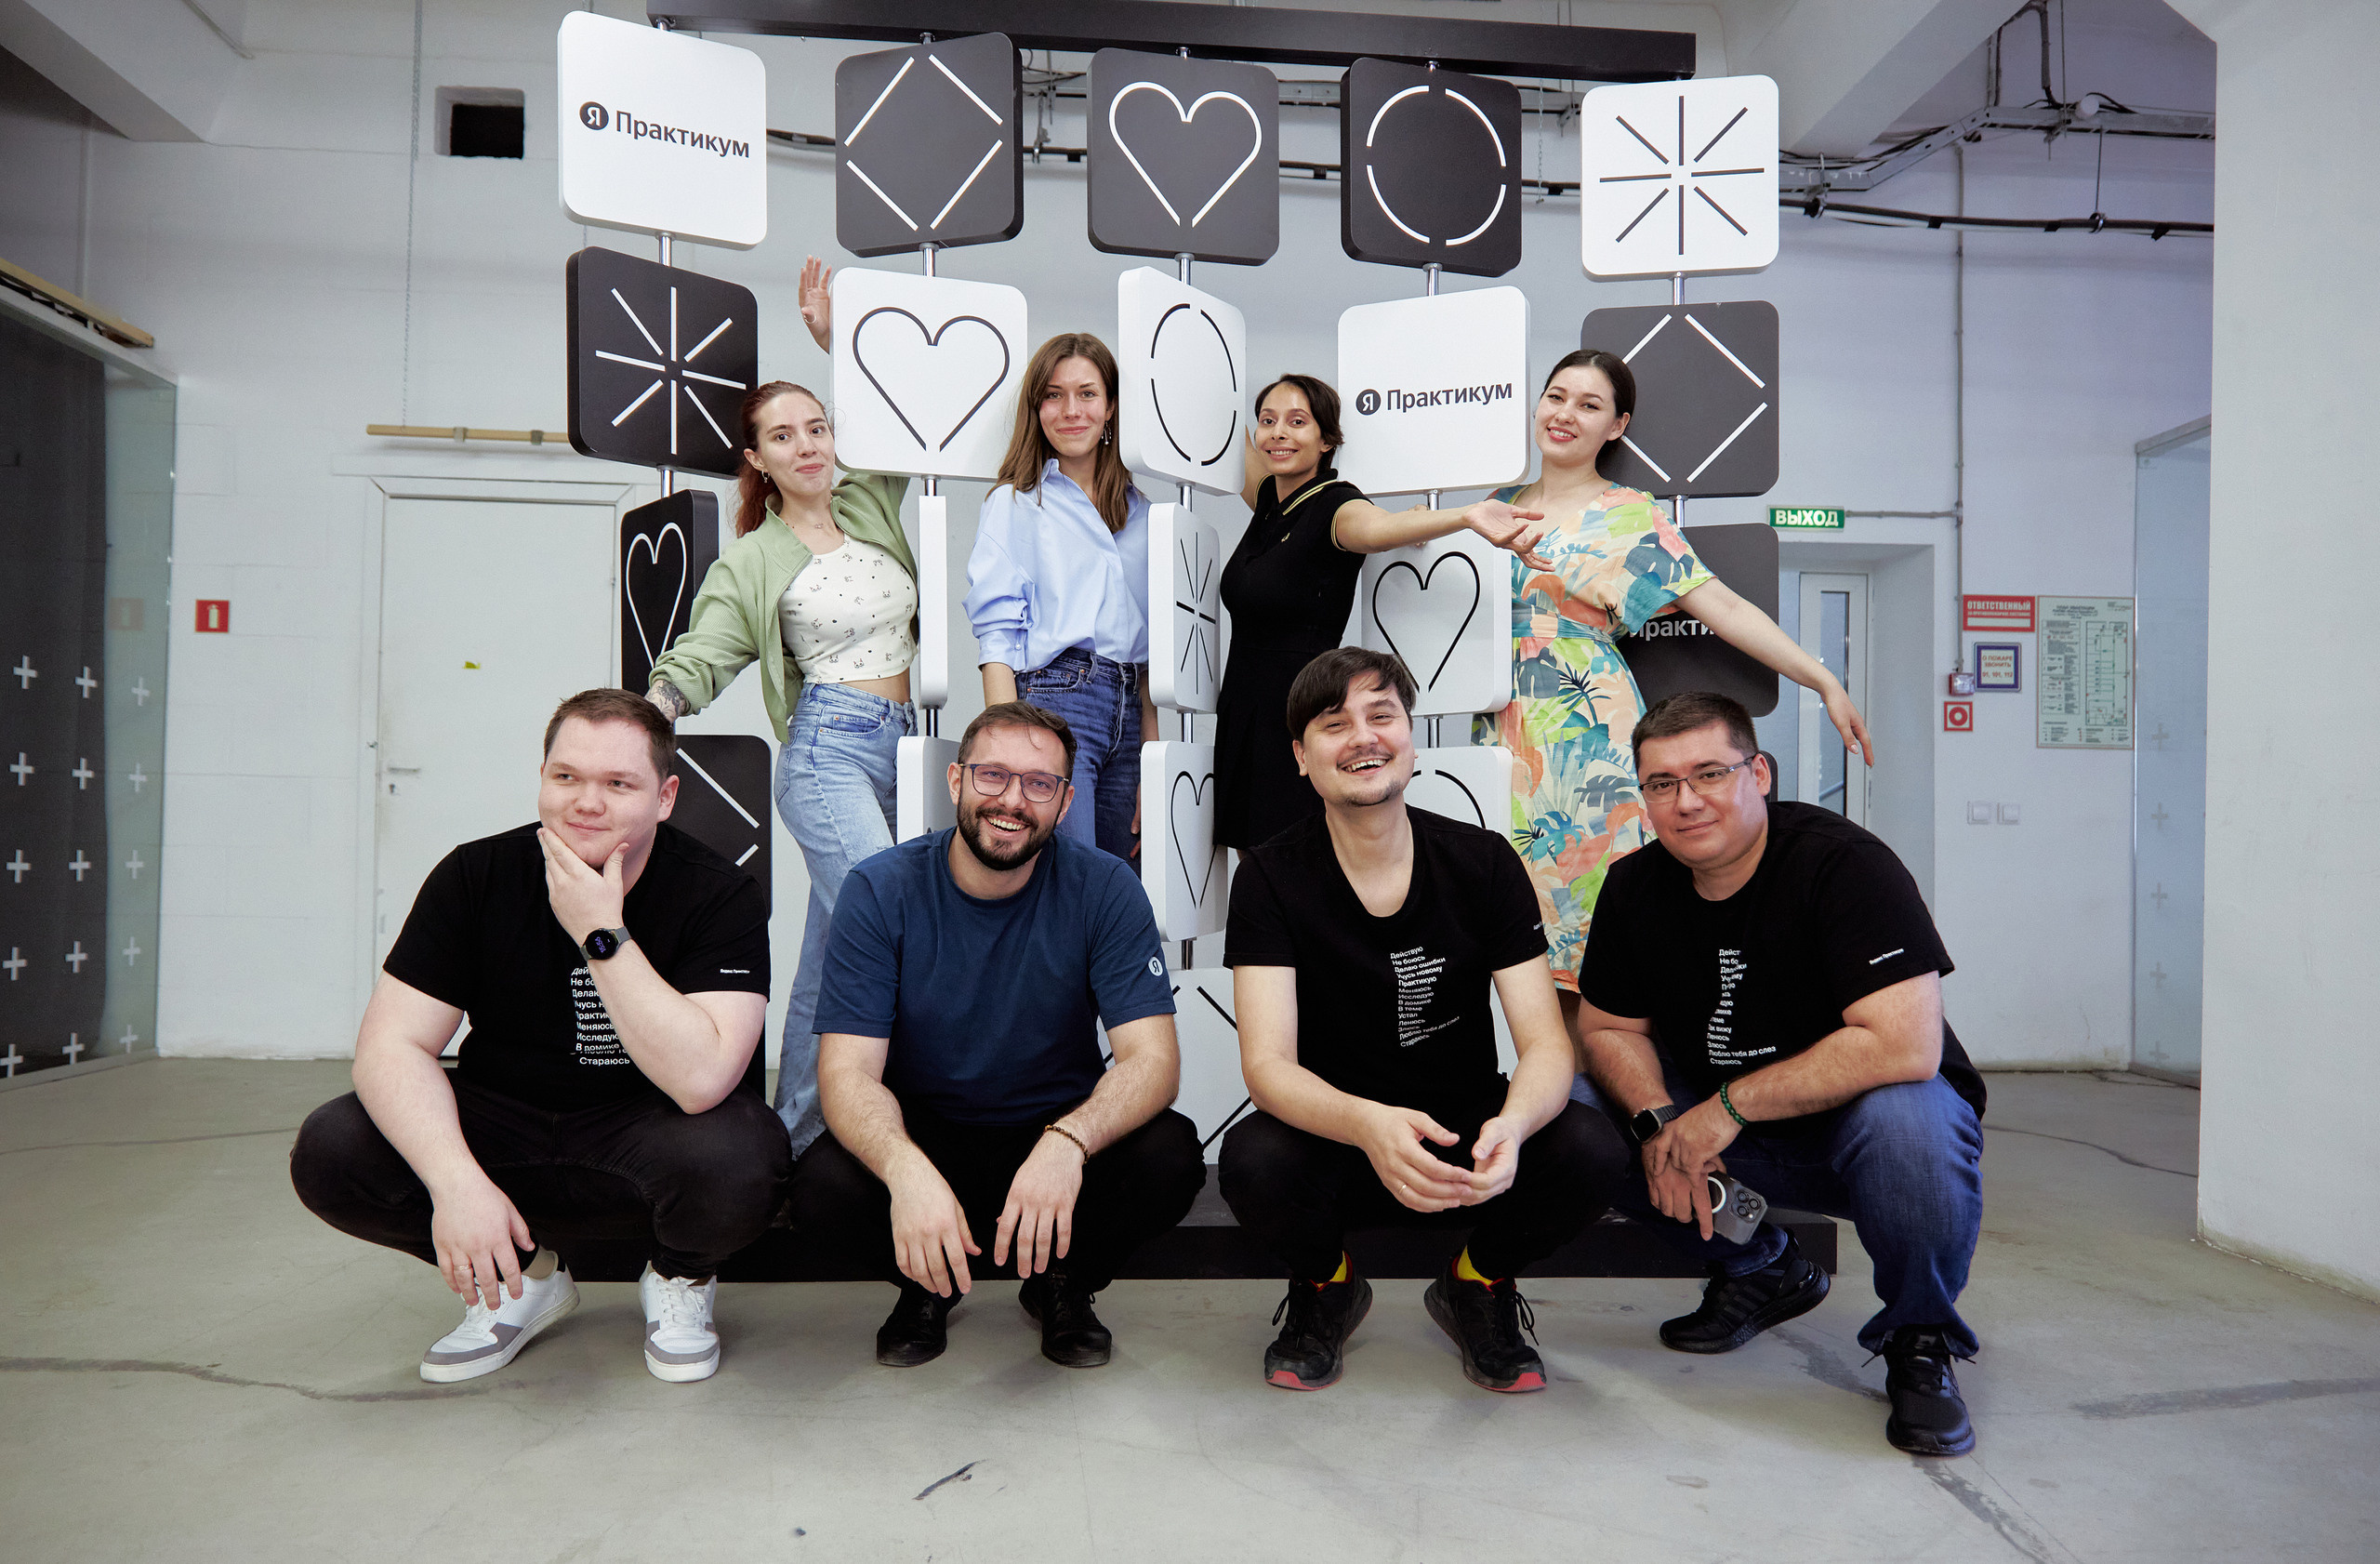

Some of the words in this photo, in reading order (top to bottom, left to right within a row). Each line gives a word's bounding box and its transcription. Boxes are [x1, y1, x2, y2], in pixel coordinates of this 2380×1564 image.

[615, 110, 749, 158] Практикум
[1387, 382, 1513, 413] Практикум
[1775, 510, 1839, 527] ВЫХОД
[1967, 601, 2030, 610] ОТВЕТСТВЕННЫЙ
[1630, 619, 1715, 642] ракти
[1390, 946, 1423, 960] Действую
[1395, 965, 1418, 974] Делаю
[1418, 957, 1447, 969] ошибки
[1403, 956, 1426, 965] боюсь
[1416, 966, 1443, 976] новому
[570, 977, 583, 987] Не
[1398, 976, 1437, 987] Практикую
[575, 1042, 582, 1052] В
[1707, 1040, 1726, 1049] Злюсь
[1709, 1049, 1731, 1057] Люблю
[579, 1056, 630, 1067] Стараюсь
[1710, 1057, 1742, 1066] Стараюсь
